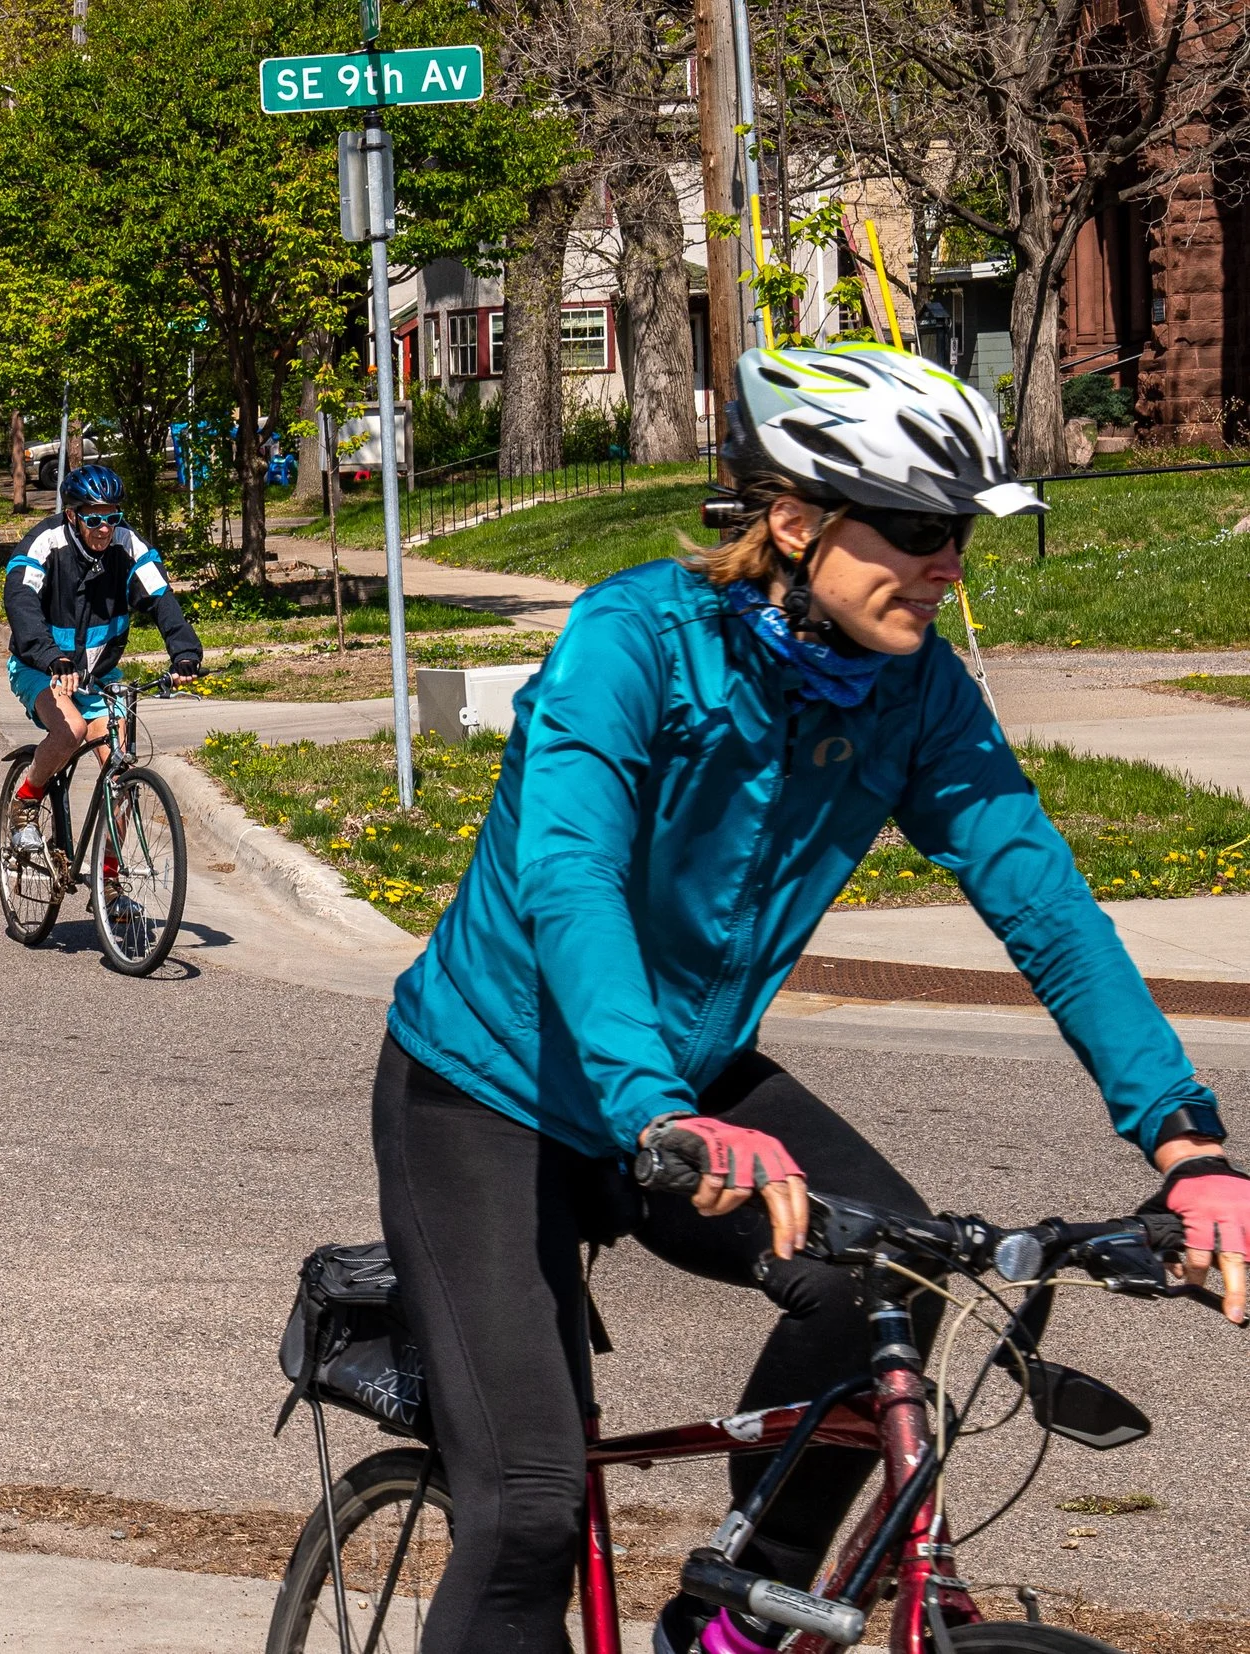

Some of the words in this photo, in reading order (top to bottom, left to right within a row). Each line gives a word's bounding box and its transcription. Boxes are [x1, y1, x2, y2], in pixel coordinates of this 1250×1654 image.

[277, 66, 324, 101] SE
[337, 62, 403, 97] 9th
[421, 59, 468, 93] Av
